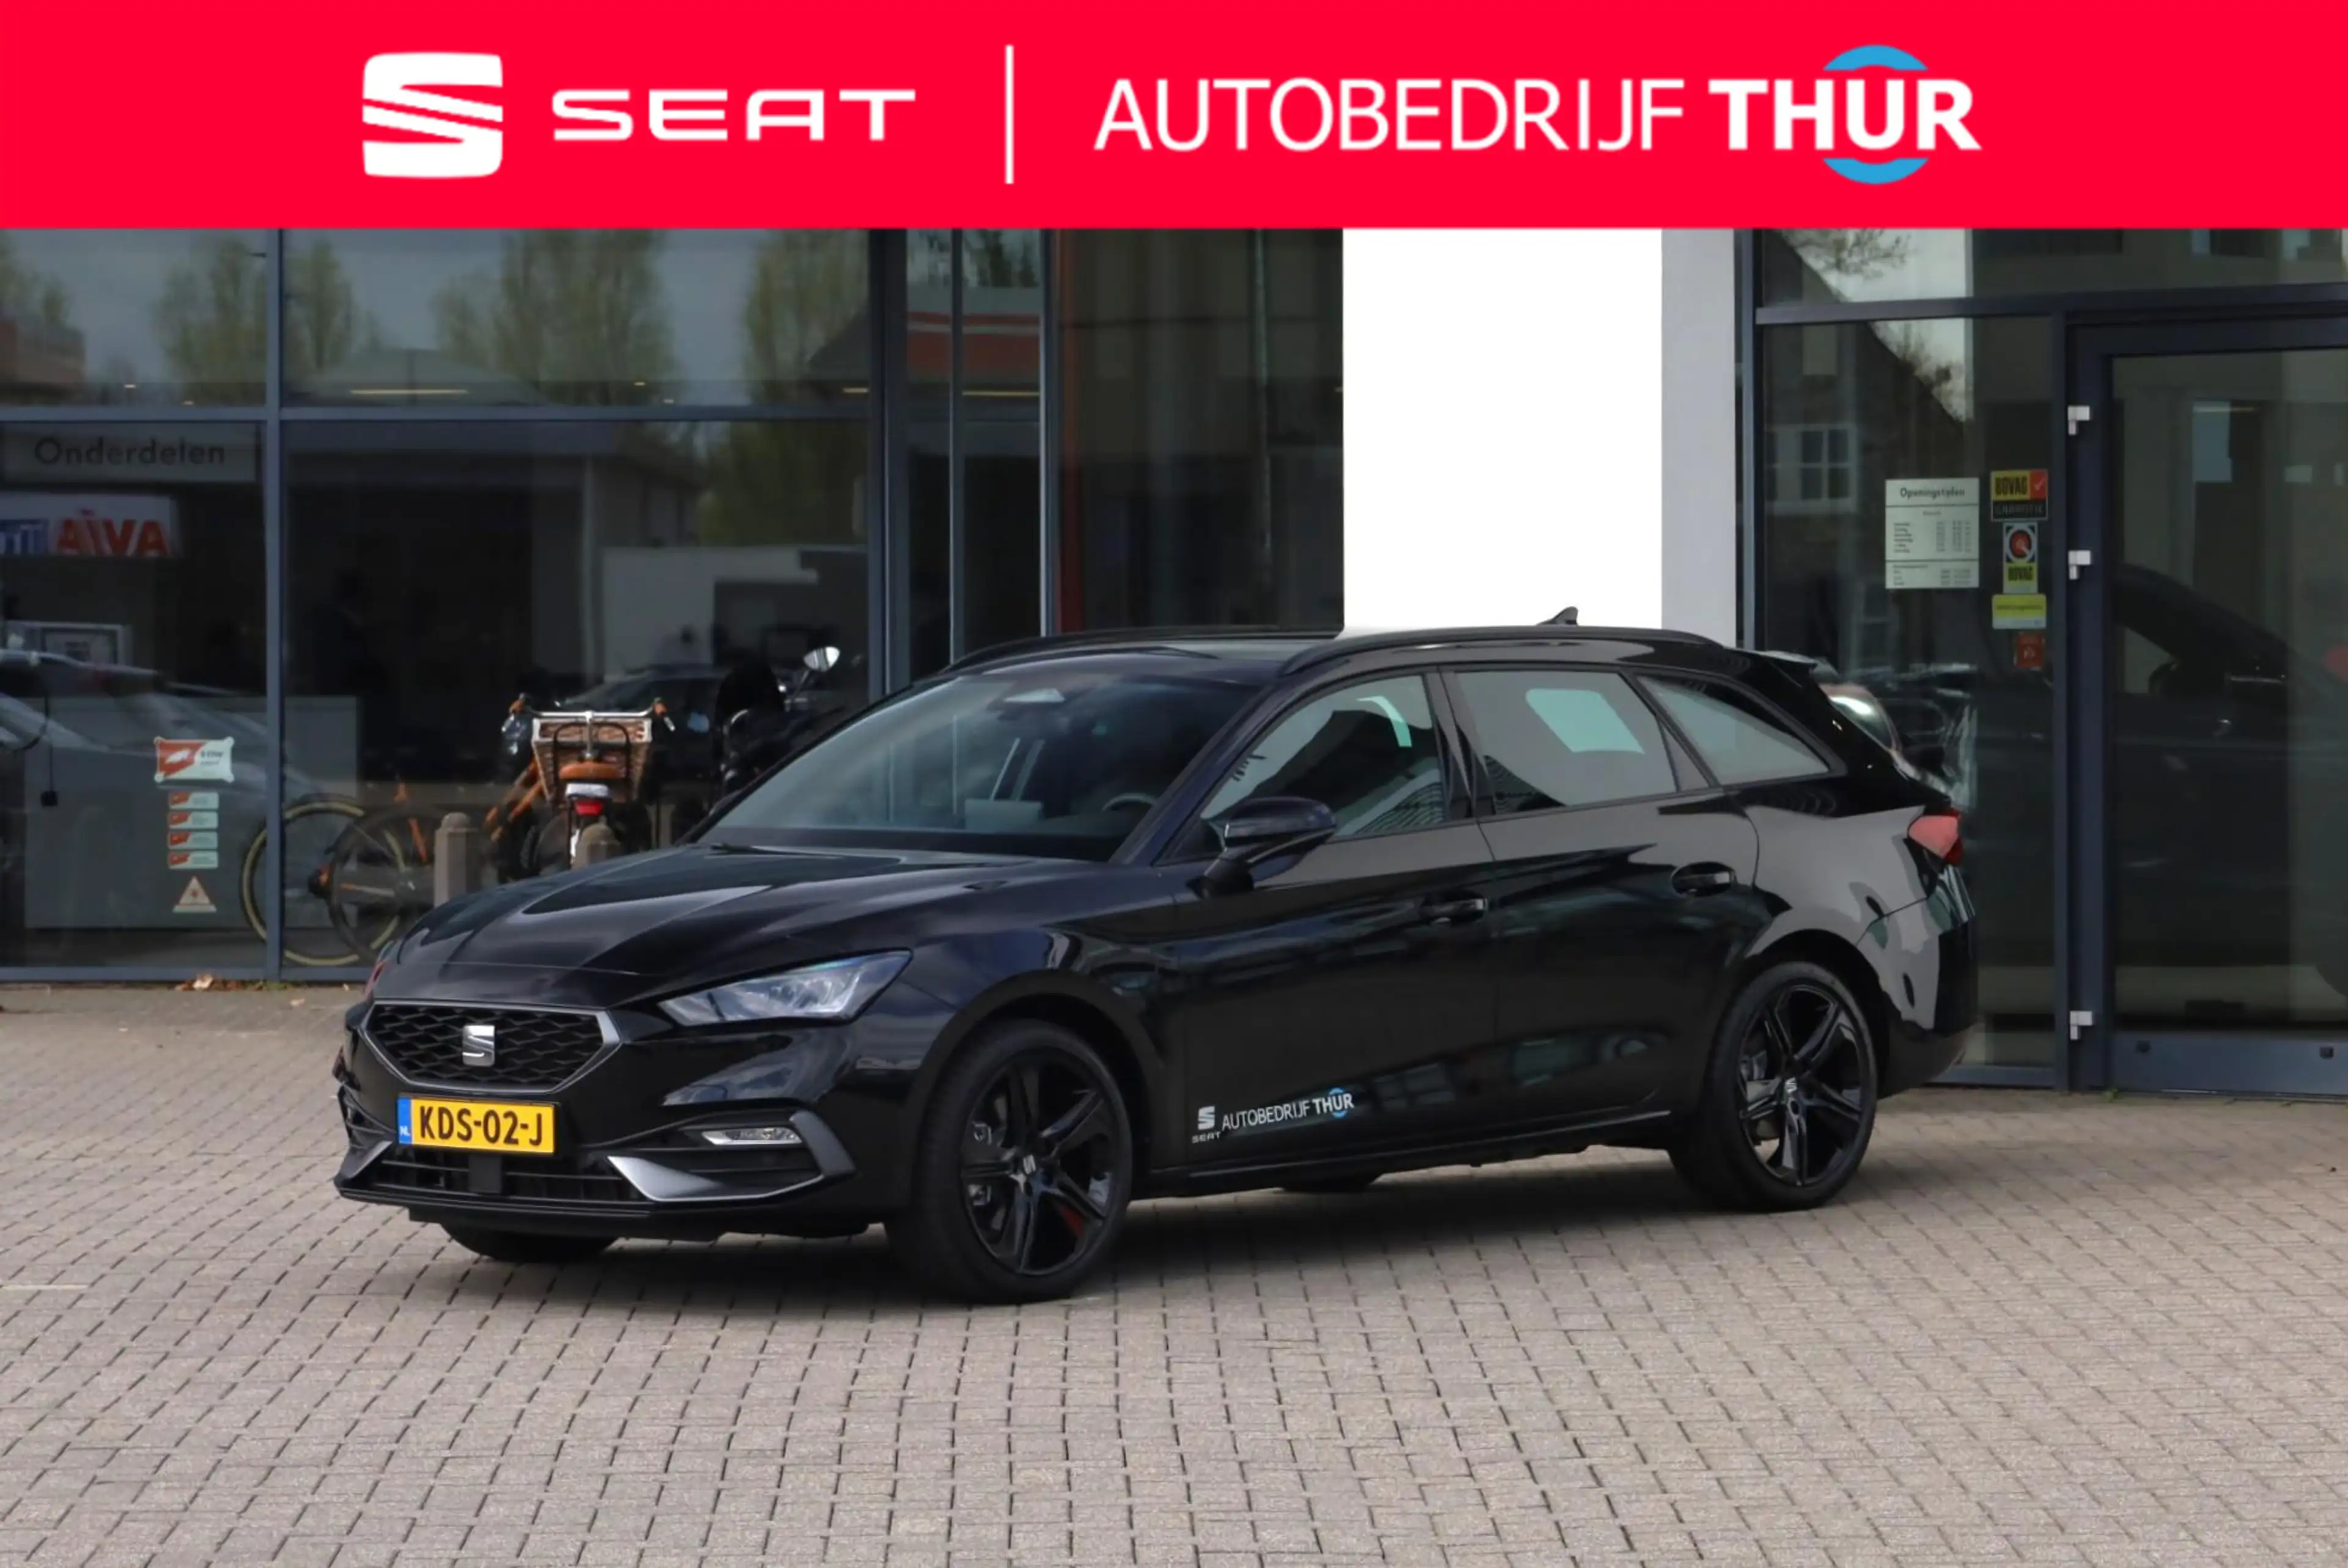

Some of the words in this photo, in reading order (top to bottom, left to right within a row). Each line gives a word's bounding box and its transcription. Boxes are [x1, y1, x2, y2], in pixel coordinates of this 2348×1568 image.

[35, 436, 224, 465] Onderdelen
[419, 1105, 543, 1146] KDS-02-J
[1222, 1099, 1312, 1132] AUTOBEDRIJF
[1312, 1092, 1355, 1115] THUR
[1192, 1131, 1222, 1144] SEAT
